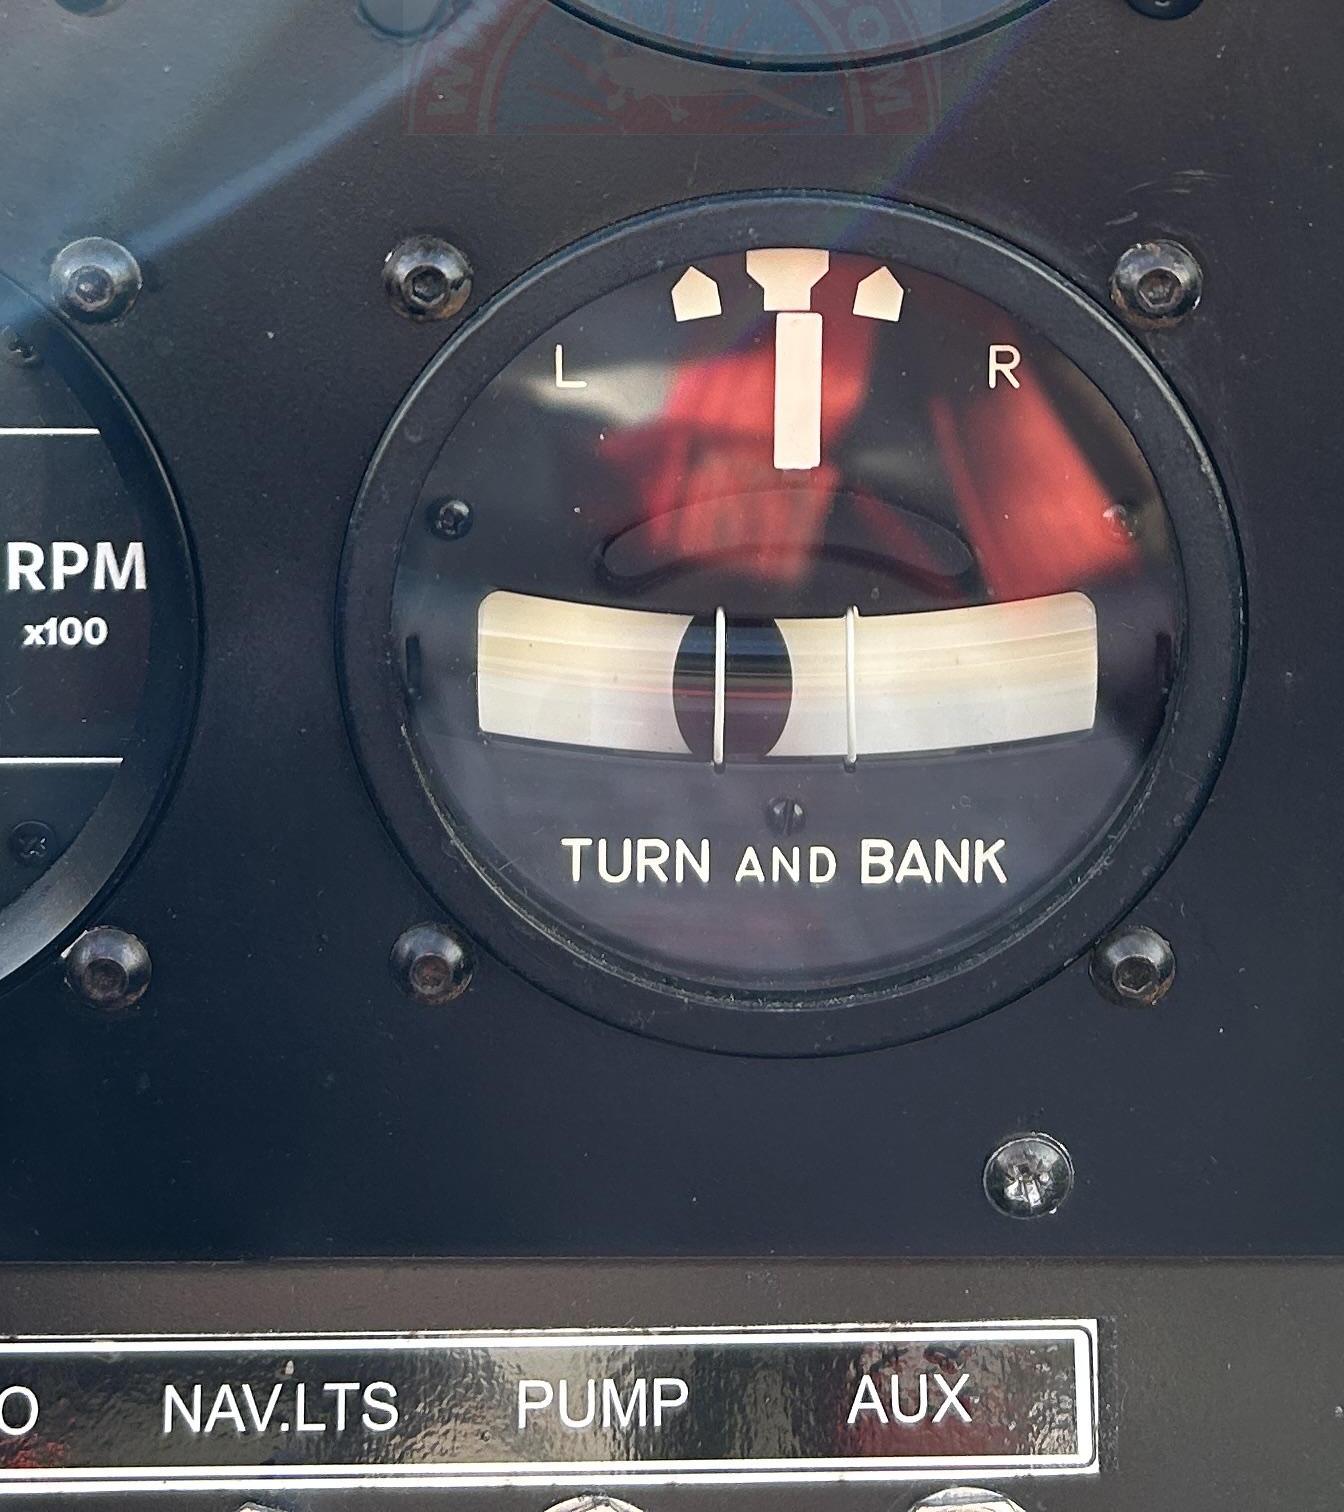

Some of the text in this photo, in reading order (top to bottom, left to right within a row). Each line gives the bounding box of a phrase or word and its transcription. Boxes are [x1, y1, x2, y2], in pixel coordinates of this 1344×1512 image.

[555, 345, 587, 388] L
[988, 344, 1021, 388] R
[6, 541, 147, 591] RPM
[22, 618, 107, 647] x100
[562, 838, 1007, 884] TURN AND BANK
[162, 1381, 399, 1434] NAV.LTS
[517, 1378, 690, 1429] PUMP
[847, 1374, 972, 1424] AUX
